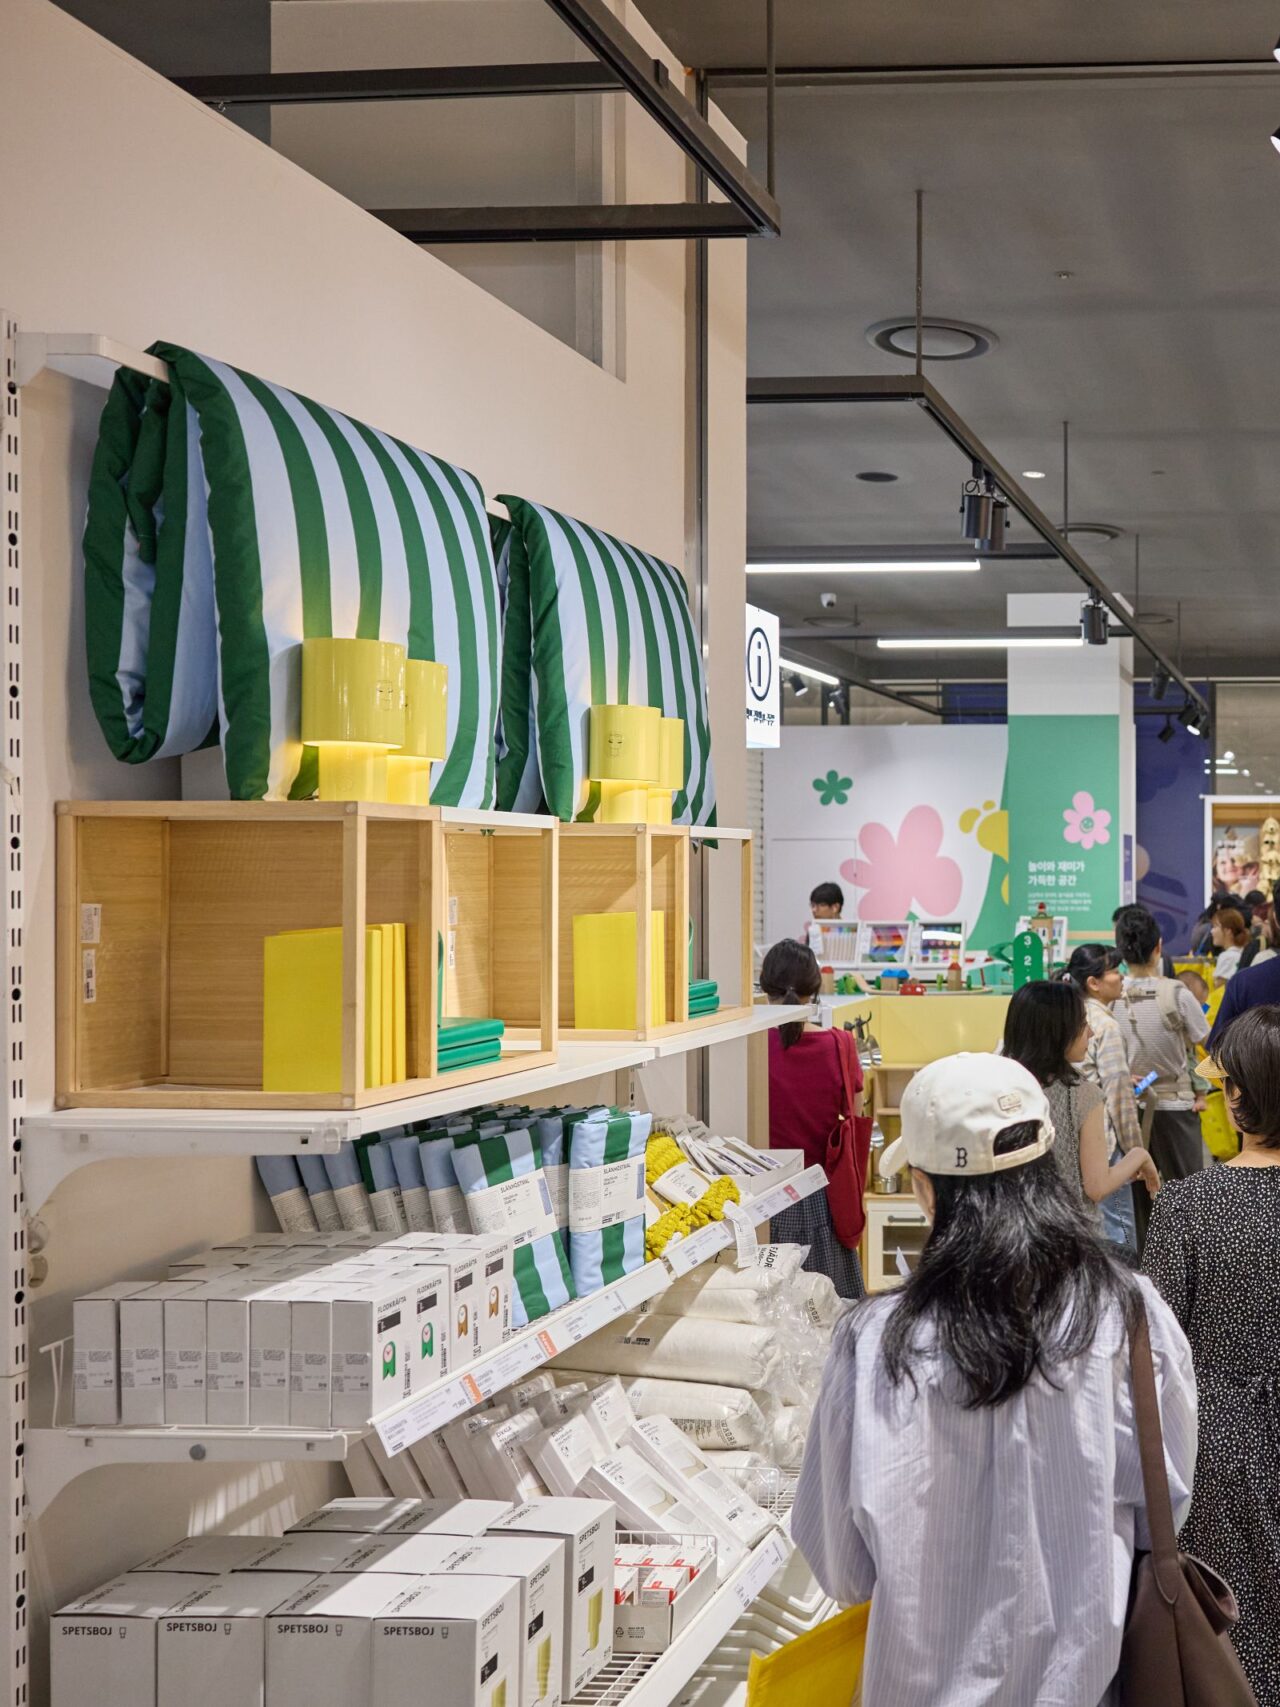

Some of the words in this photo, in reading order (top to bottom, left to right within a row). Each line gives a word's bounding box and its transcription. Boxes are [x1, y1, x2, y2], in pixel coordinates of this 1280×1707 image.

[1023, 935, 1032, 946] 3
[1023, 955, 1032, 966] 2
[955, 1147, 968, 1168] B
[764, 1246, 779, 1268] FJÄDR
[481, 1602, 505, 1631] SPETSBOJ
[62, 1626, 113, 1636] SPETSBOJ
[167, 1622, 218, 1633] SPETSBOJ
[277, 1624, 328, 1634] SPETSBOJ
[383, 1626, 435, 1636] SPETSBOJ
